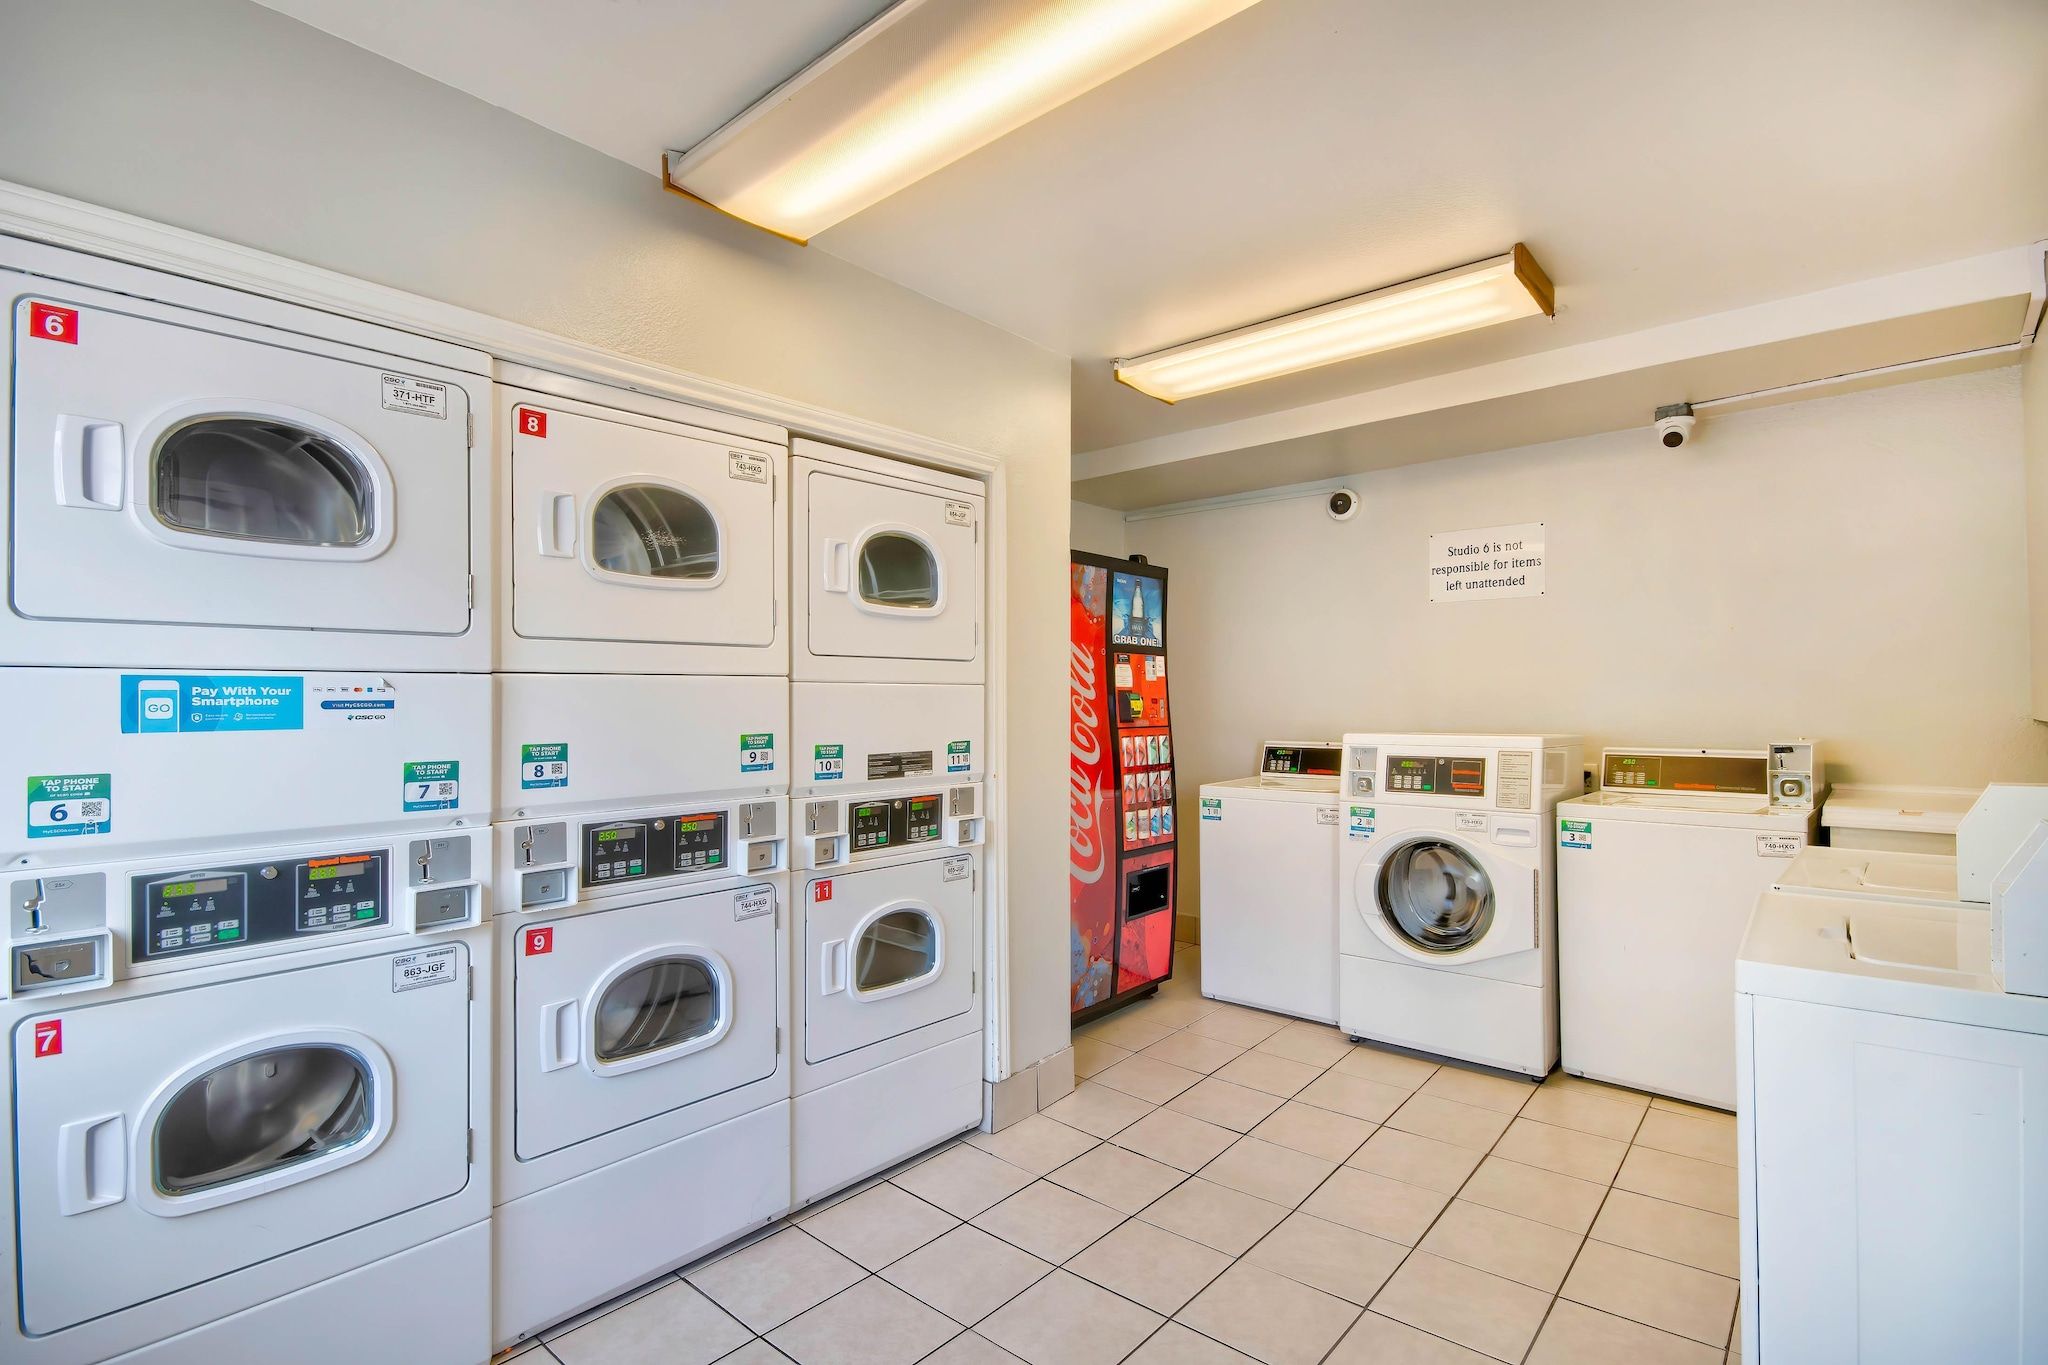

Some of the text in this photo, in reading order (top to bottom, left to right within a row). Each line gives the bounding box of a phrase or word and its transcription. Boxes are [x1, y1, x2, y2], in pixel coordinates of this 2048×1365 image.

[45, 315, 64, 336] 6
[393, 389, 436, 404] 371-HTF
[527, 416, 539, 432] 8
[1447, 541, 1523, 557] Studio 6 is not
[1431, 557, 1542, 576] responsible for items
[1446, 574, 1526, 591] left unattended
[1113, 634, 1138, 645] GRAB
[191, 686, 292, 699] Pay With Your
[148, 704, 171, 713] GO
[191, 696, 280, 707] Smartphone
[749, 751, 757, 763] 9
[951, 755, 960, 765] 11
[533, 764, 544, 778] 8
[819, 760, 832, 772] 10
[41, 777, 100, 787] TAP PHONE
[62, 783, 96, 791] START
[418, 784, 430, 799] 7
[50, 803, 68, 822] 6
[1357, 817, 1363, 826] 2
[1569, 832, 1576, 842] 3
[815, 885, 829, 899] 11
[533, 934, 545, 951] 9
[403, 962, 446, 978] 863-JGF
[37, 1029, 58, 1052] 7
